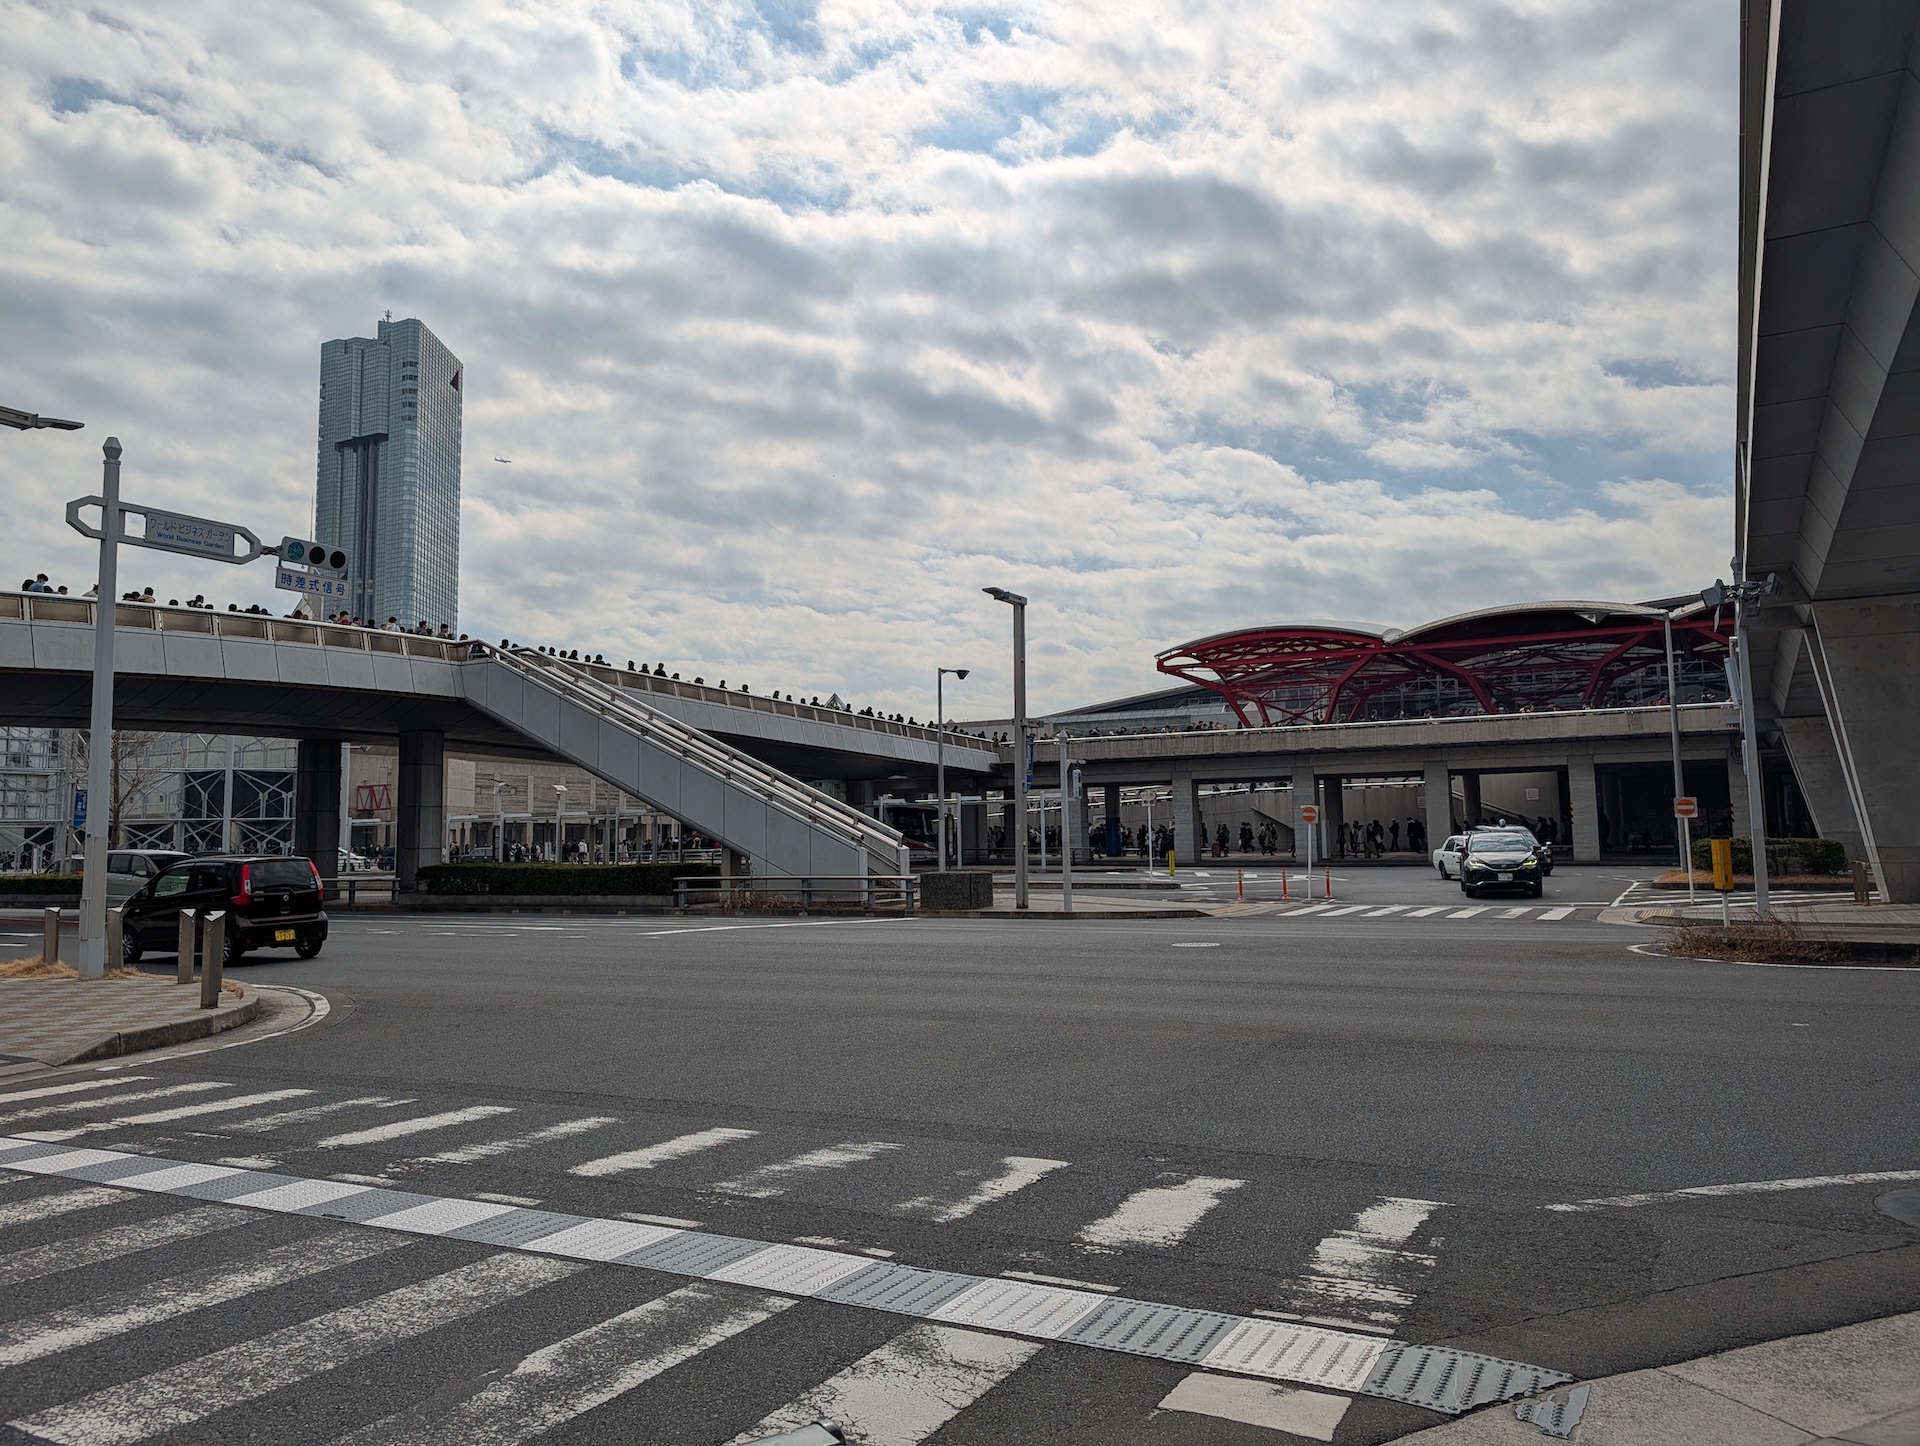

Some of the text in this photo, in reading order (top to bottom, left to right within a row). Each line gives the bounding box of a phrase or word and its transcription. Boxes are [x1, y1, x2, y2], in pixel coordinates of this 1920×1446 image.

[156, 531, 225, 549] World Business Garden
[281, 573, 346, 596] 時差式信号
